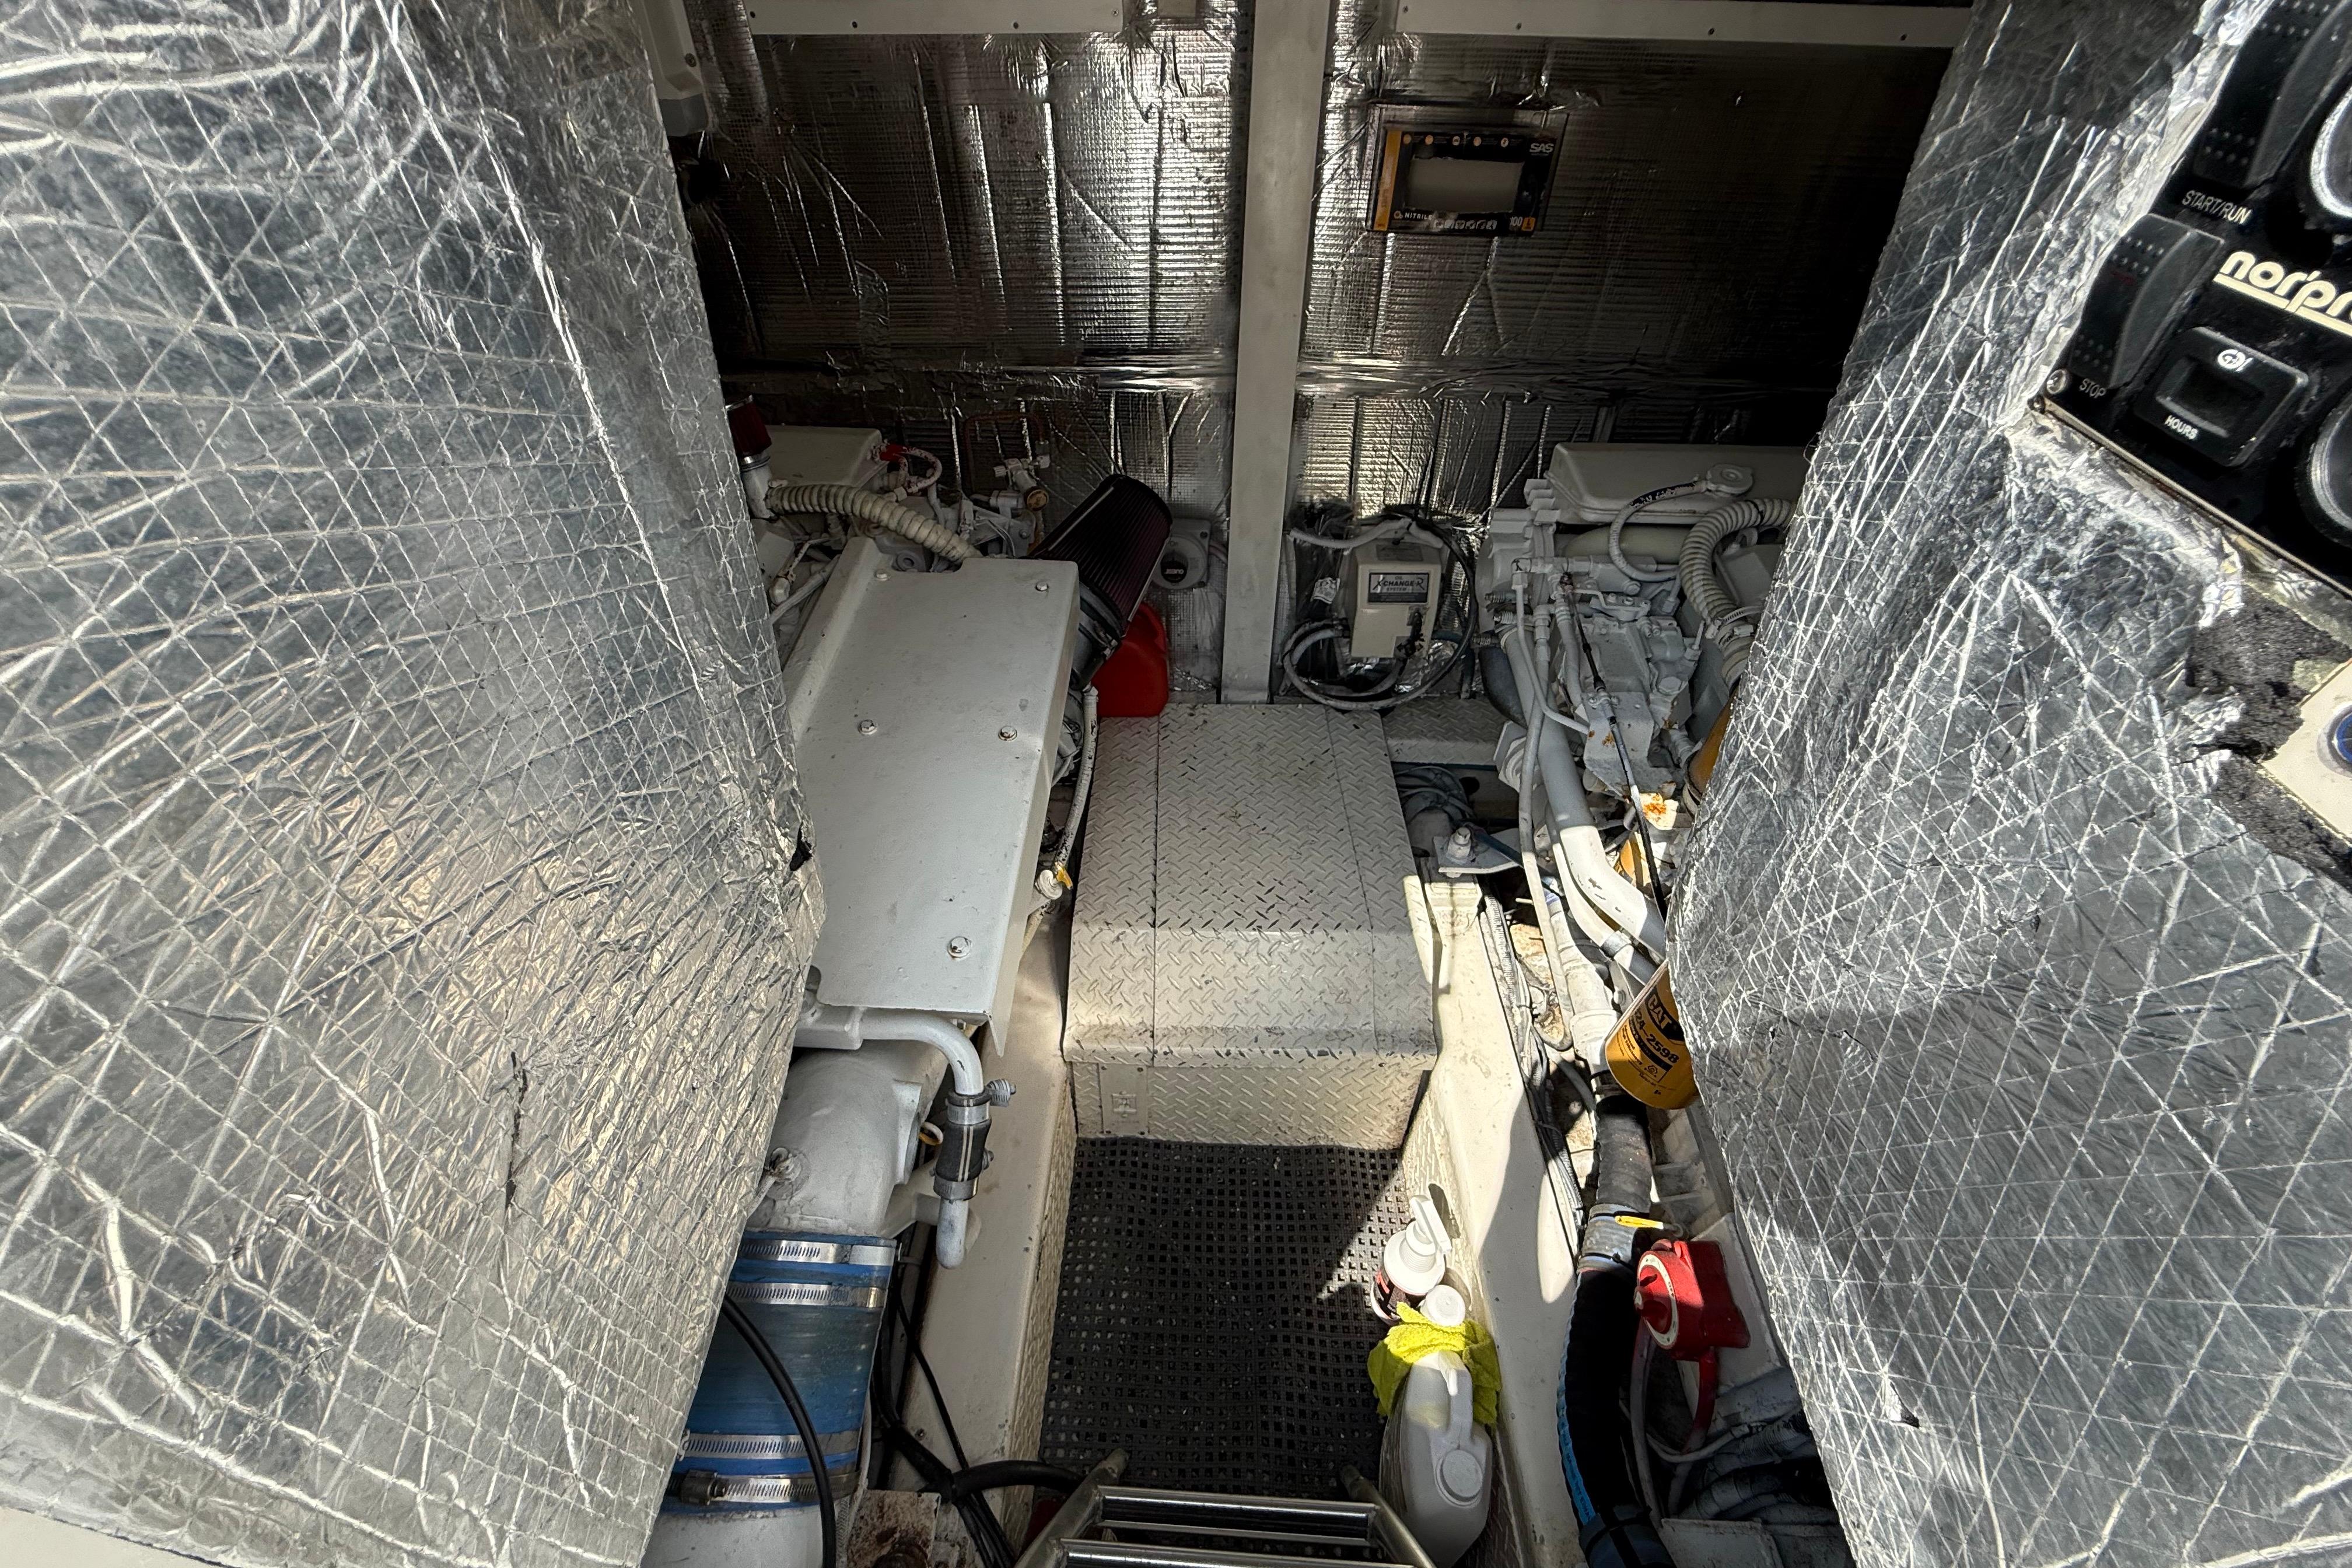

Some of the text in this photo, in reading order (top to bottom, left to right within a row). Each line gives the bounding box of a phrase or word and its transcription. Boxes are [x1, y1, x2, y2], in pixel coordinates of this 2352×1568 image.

[1530, 142, 1554, 153] SAS
[2182, 190, 2253, 225] START/RUN
[1510, 216, 1523, 226] 100
[2078, 377, 2107, 399] STOP
[2165, 415, 2199, 440] HOURS
[1647, 993, 1672, 1029] CAT
